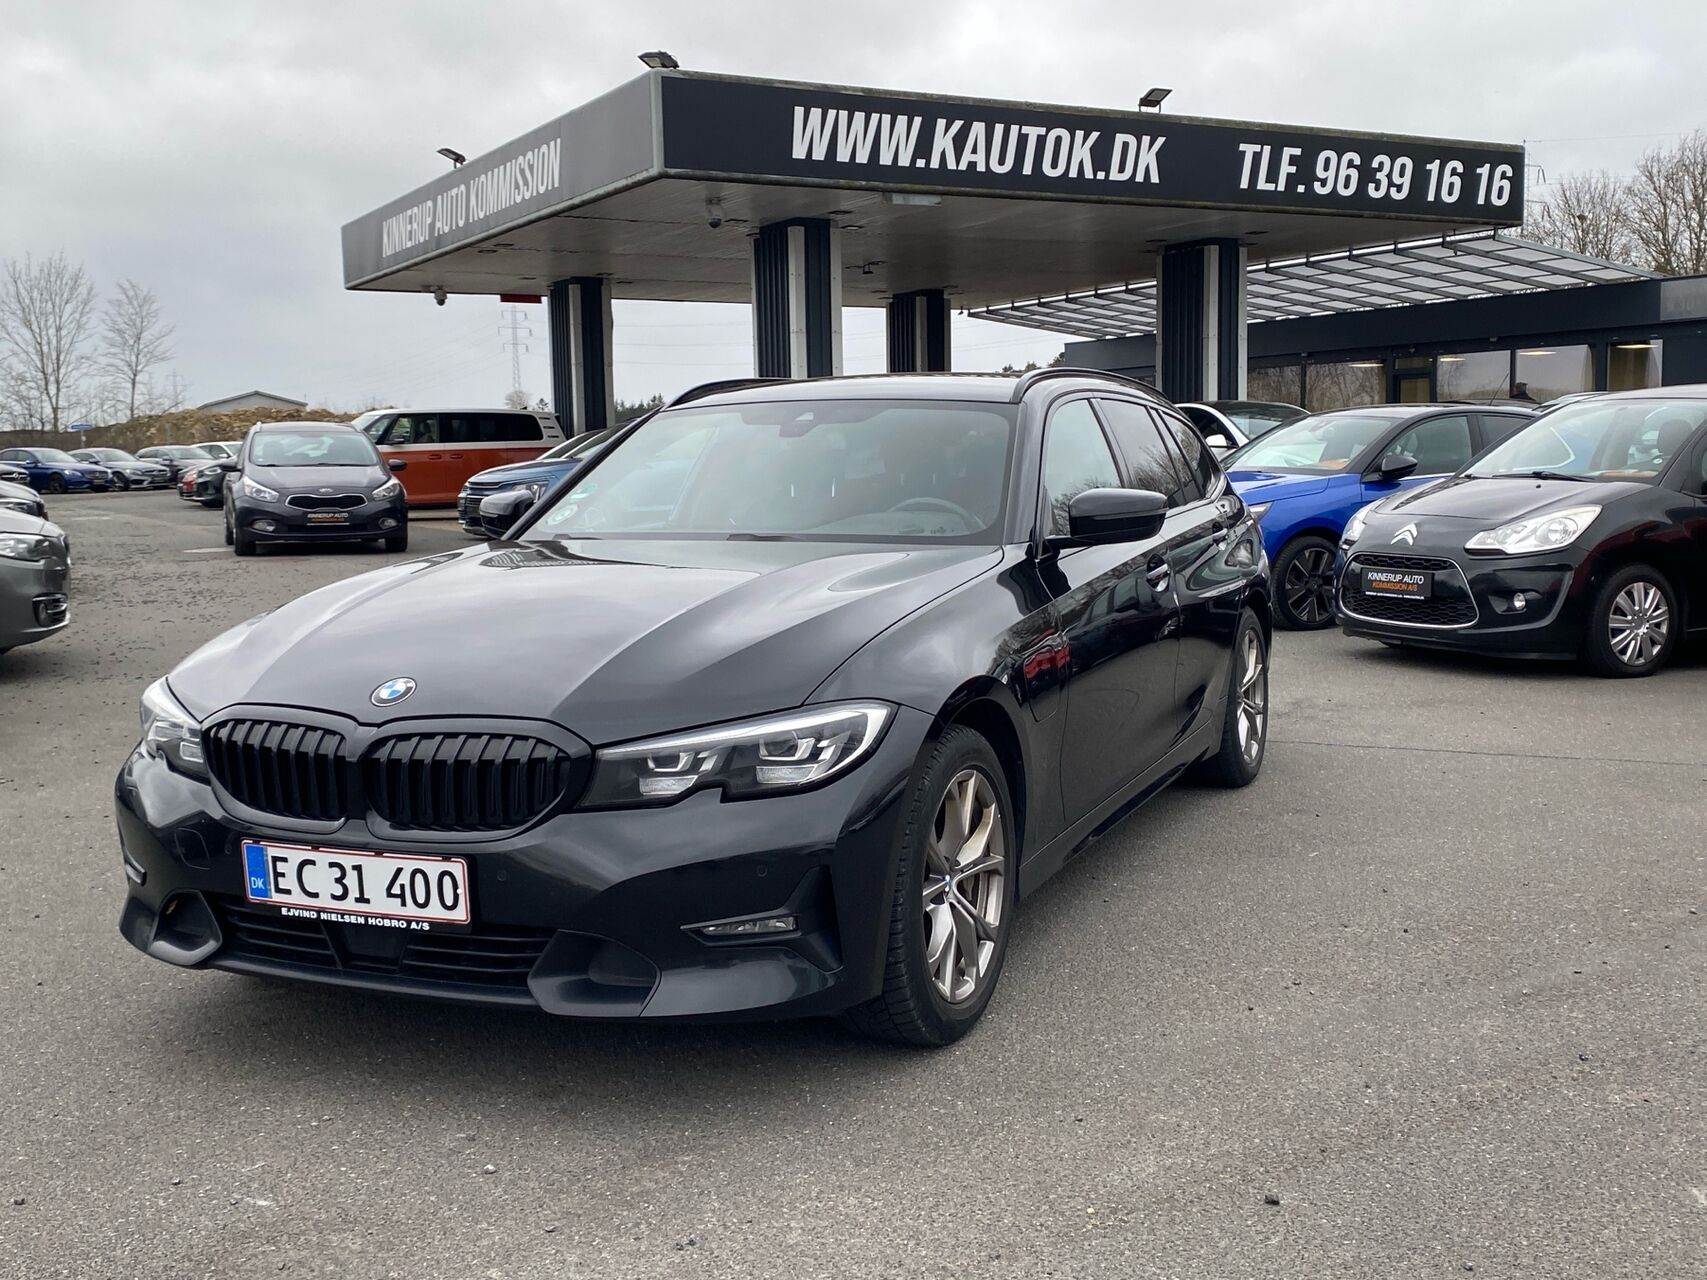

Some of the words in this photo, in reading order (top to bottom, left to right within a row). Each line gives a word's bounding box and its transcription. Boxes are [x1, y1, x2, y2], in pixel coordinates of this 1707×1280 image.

[792, 106, 1167, 184] WWW.KAUTOK.DK
[382, 200, 433, 258] KINNERUP
[434, 183, 466, 237] AUTO
[469, 138, 561, 223] KOMMISSION
[1239, 143, 1305, 193] TLF.
[1313, 150, 1361, 197] 96
[1368, 154, 1414, 200] 39
[1425, 159, 1464, 203] 16
[1476, 163, 1513, 207] 16
[1367, 571, 1403, 583] KINNERUP
[1403, 574, 1424, 584] AUTO
[251, 877, 265, 890] DK
[385, 866, 460, 912] 400
[281, 907, 317, 919] EJVIND
[320, 912, 365, 925] NIELSEN
[368, 917, 407, 929] HOBRO
[410, 921, 430, 931] A/S
